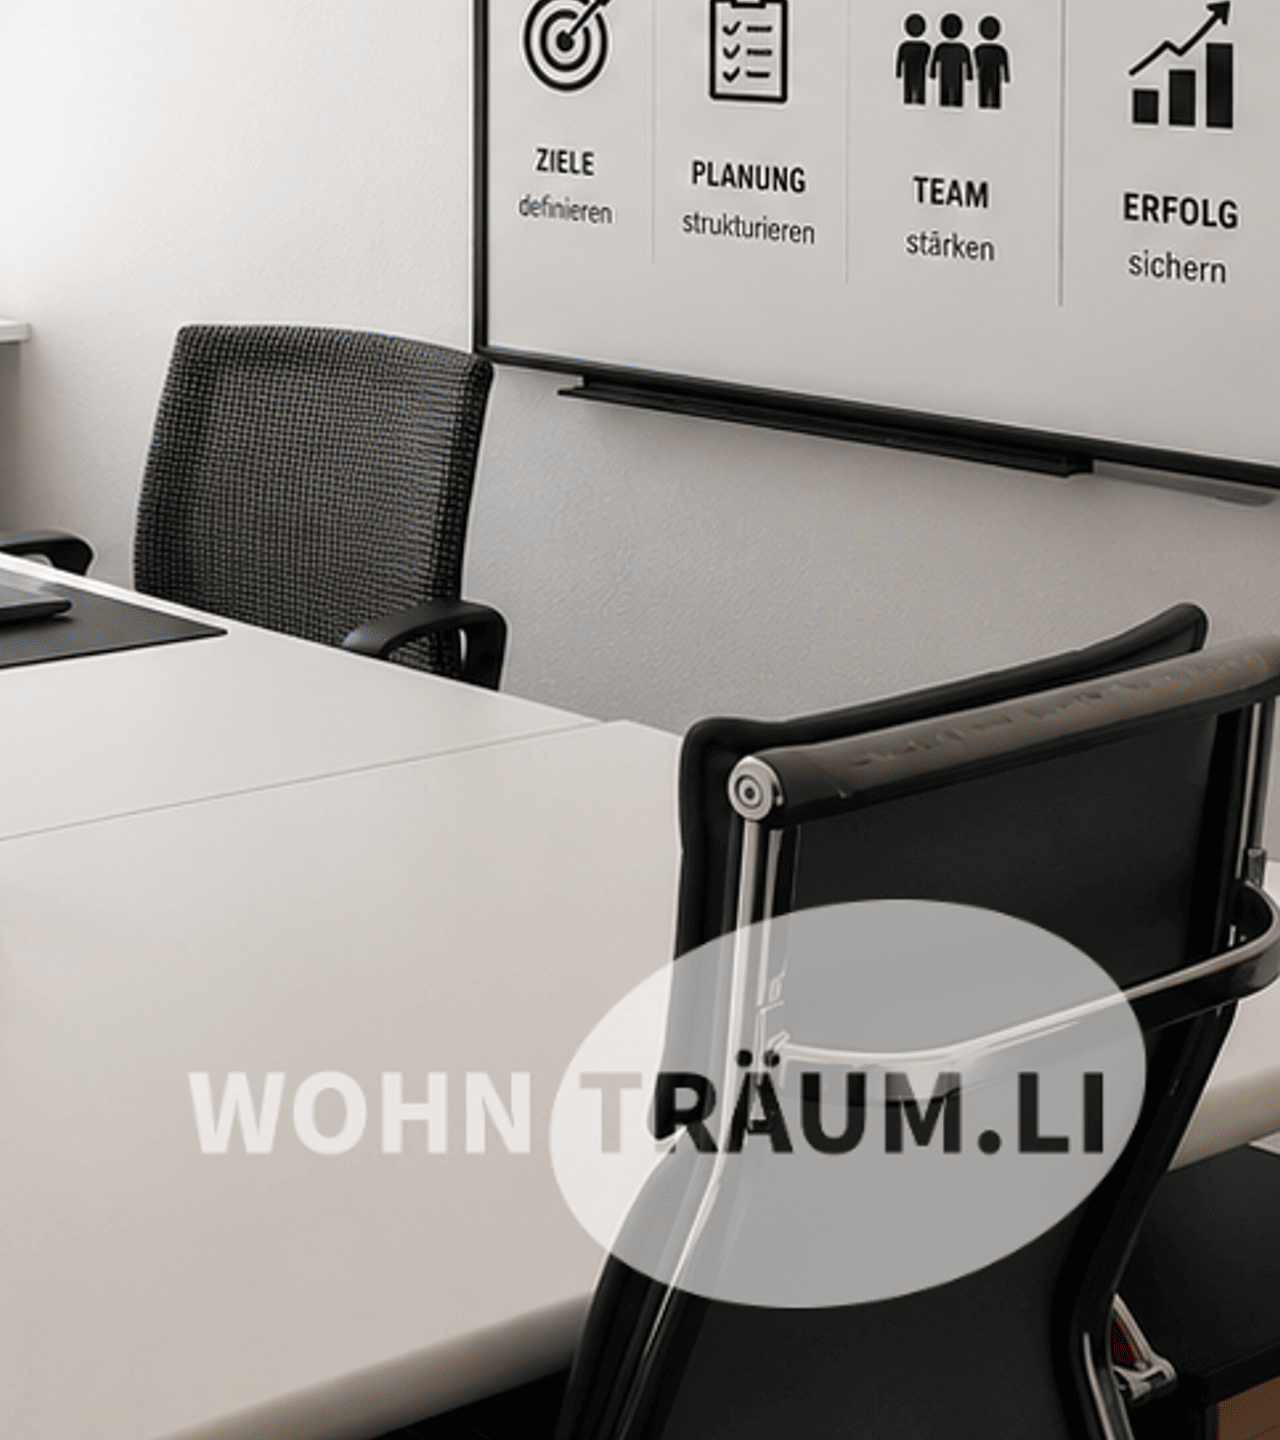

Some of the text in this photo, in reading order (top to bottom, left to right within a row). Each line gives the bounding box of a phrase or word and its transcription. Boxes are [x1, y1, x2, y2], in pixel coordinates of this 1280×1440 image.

[536, 148, 594, 176] ZIELE
[692, 160, 806, 194] PLANUNG
[519, 194, 612, 223] definieren
[913, 176, 988, 209] TEAM
[1124, 192, 1238, 229] ERFOLG
[683, 212, 814, 244] strukturieren
[907, 231, 994, 261] stärken
[1129, 249, 1226, 283] sichern
